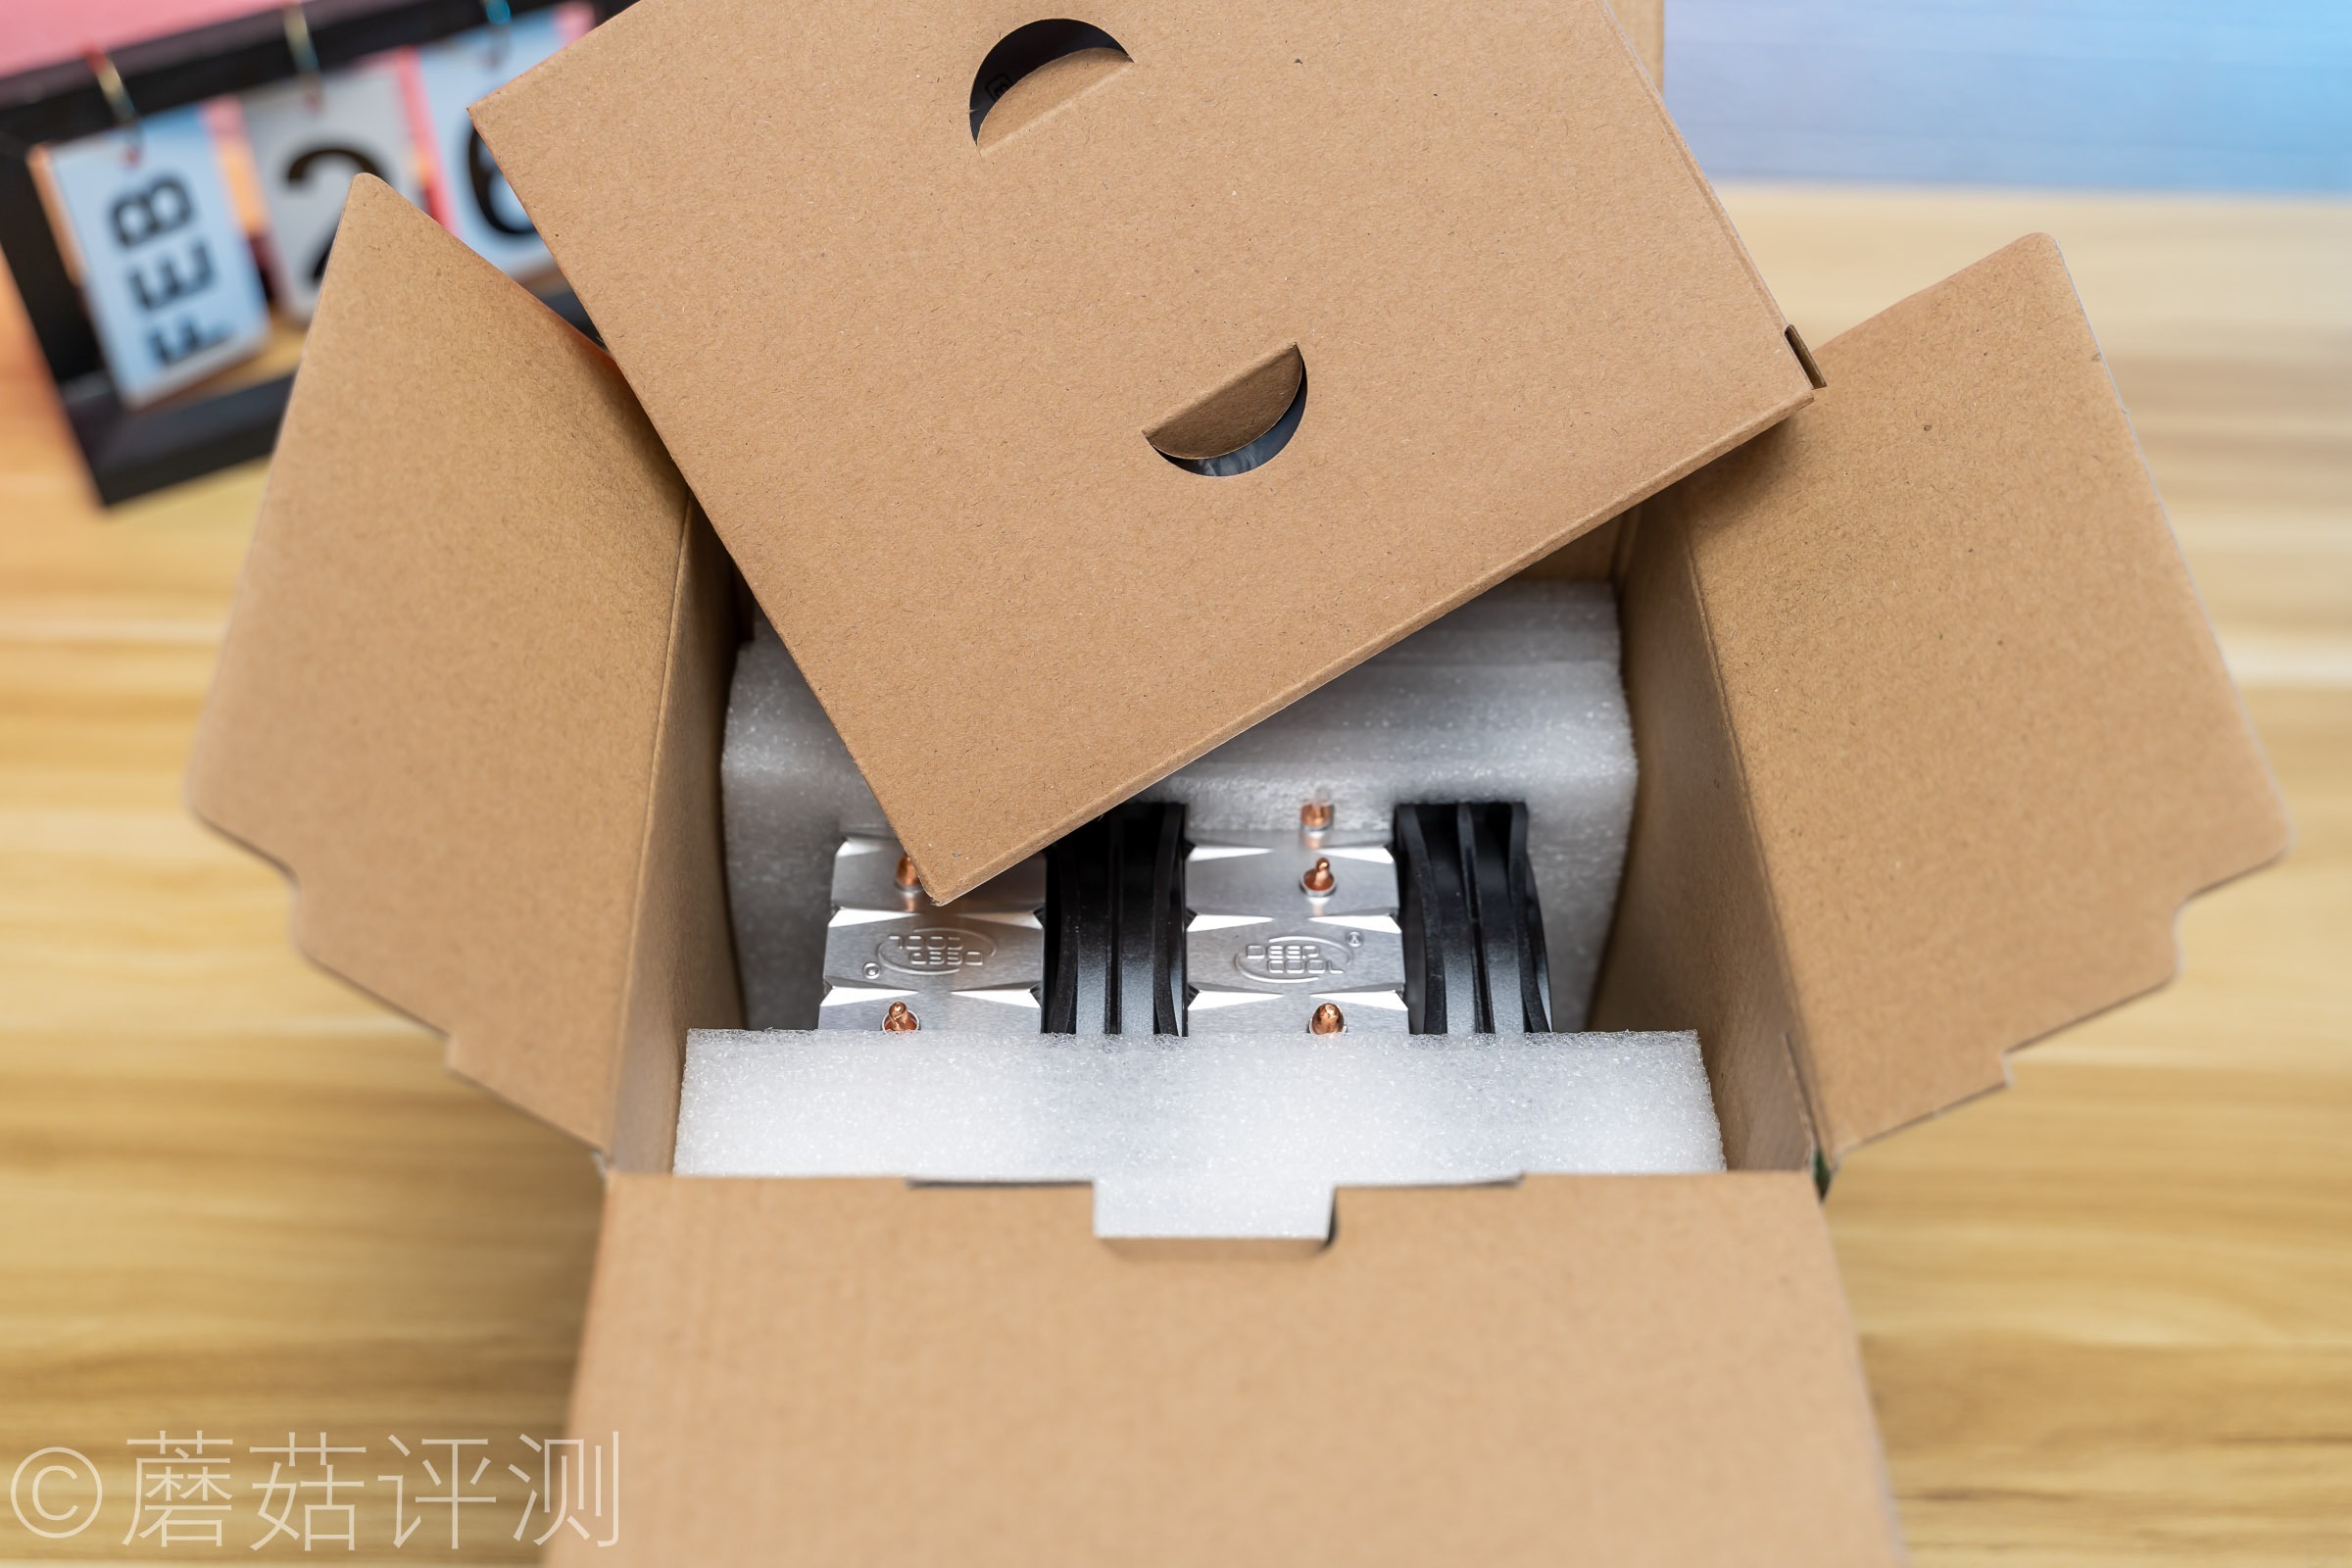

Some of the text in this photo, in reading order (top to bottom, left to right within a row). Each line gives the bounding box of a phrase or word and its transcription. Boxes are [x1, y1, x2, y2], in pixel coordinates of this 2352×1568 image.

[110, 171, 234, 368] FEB
[889, 935, 964, 951] COOL
[908, 951, 983, 966] DEEP
[1247, 945, 1319, 959] DEEP
[1268, 960, 1345, 974] COOL
